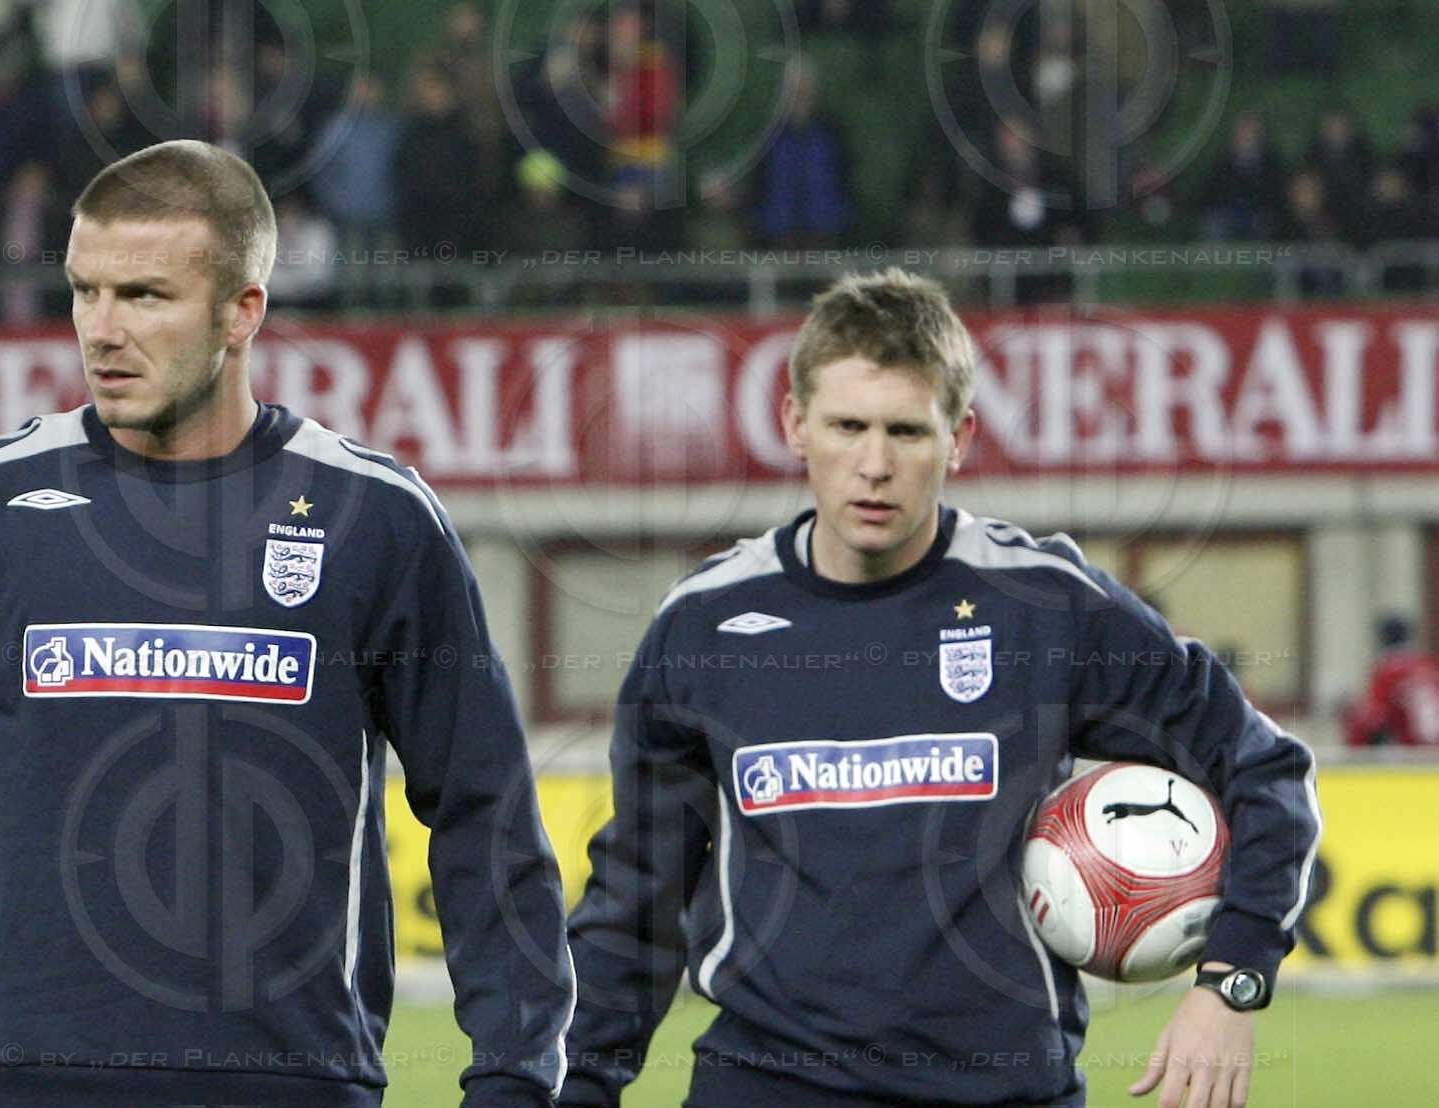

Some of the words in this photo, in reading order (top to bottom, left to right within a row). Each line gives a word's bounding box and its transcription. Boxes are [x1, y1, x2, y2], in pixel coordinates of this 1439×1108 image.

[268, 523, 325, 539] ENGLAND
[81, 637, 299, 686] Nationwide
[789, 747, 984, 790] Nationwide
